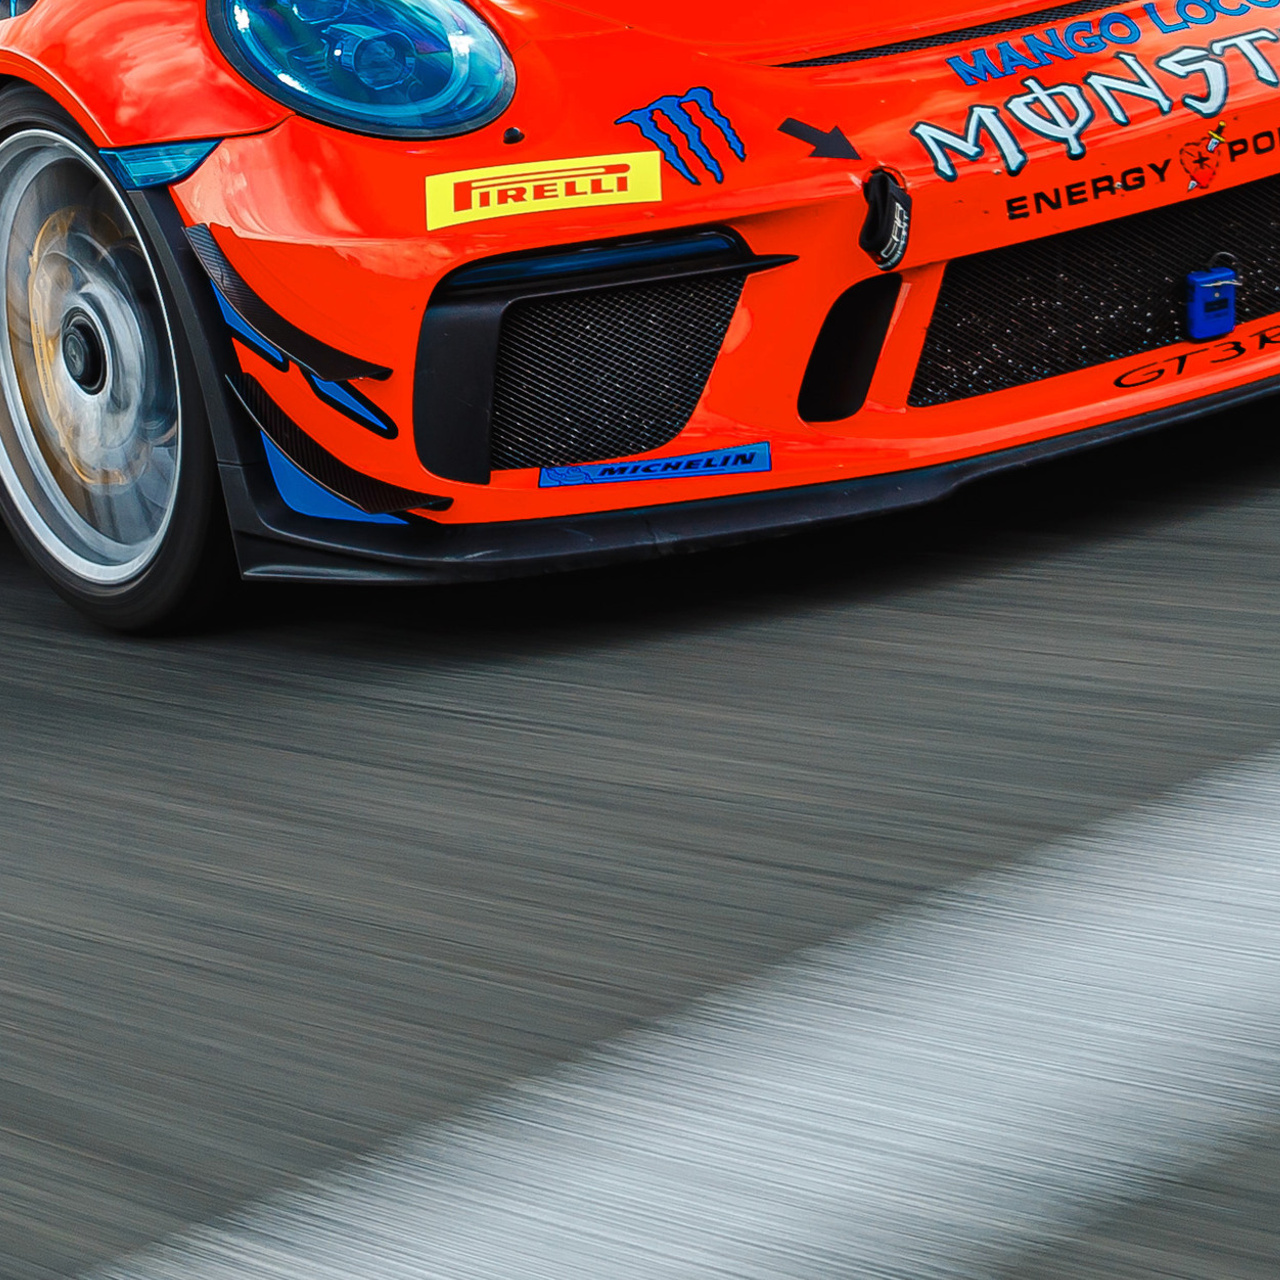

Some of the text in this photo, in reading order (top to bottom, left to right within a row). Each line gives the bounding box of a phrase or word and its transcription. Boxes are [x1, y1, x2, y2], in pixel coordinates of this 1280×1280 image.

[945, 12, 1141, 86] MANGO
[911, 26, 1280, 183] MONST
[453, 163, 632, 213] PIRELLI
[1005, 127, 1280, 220] ENERGY PO
[1113, 325, 1280, 388] GT3R
[598, 451, 757, 477] MICHELIN
